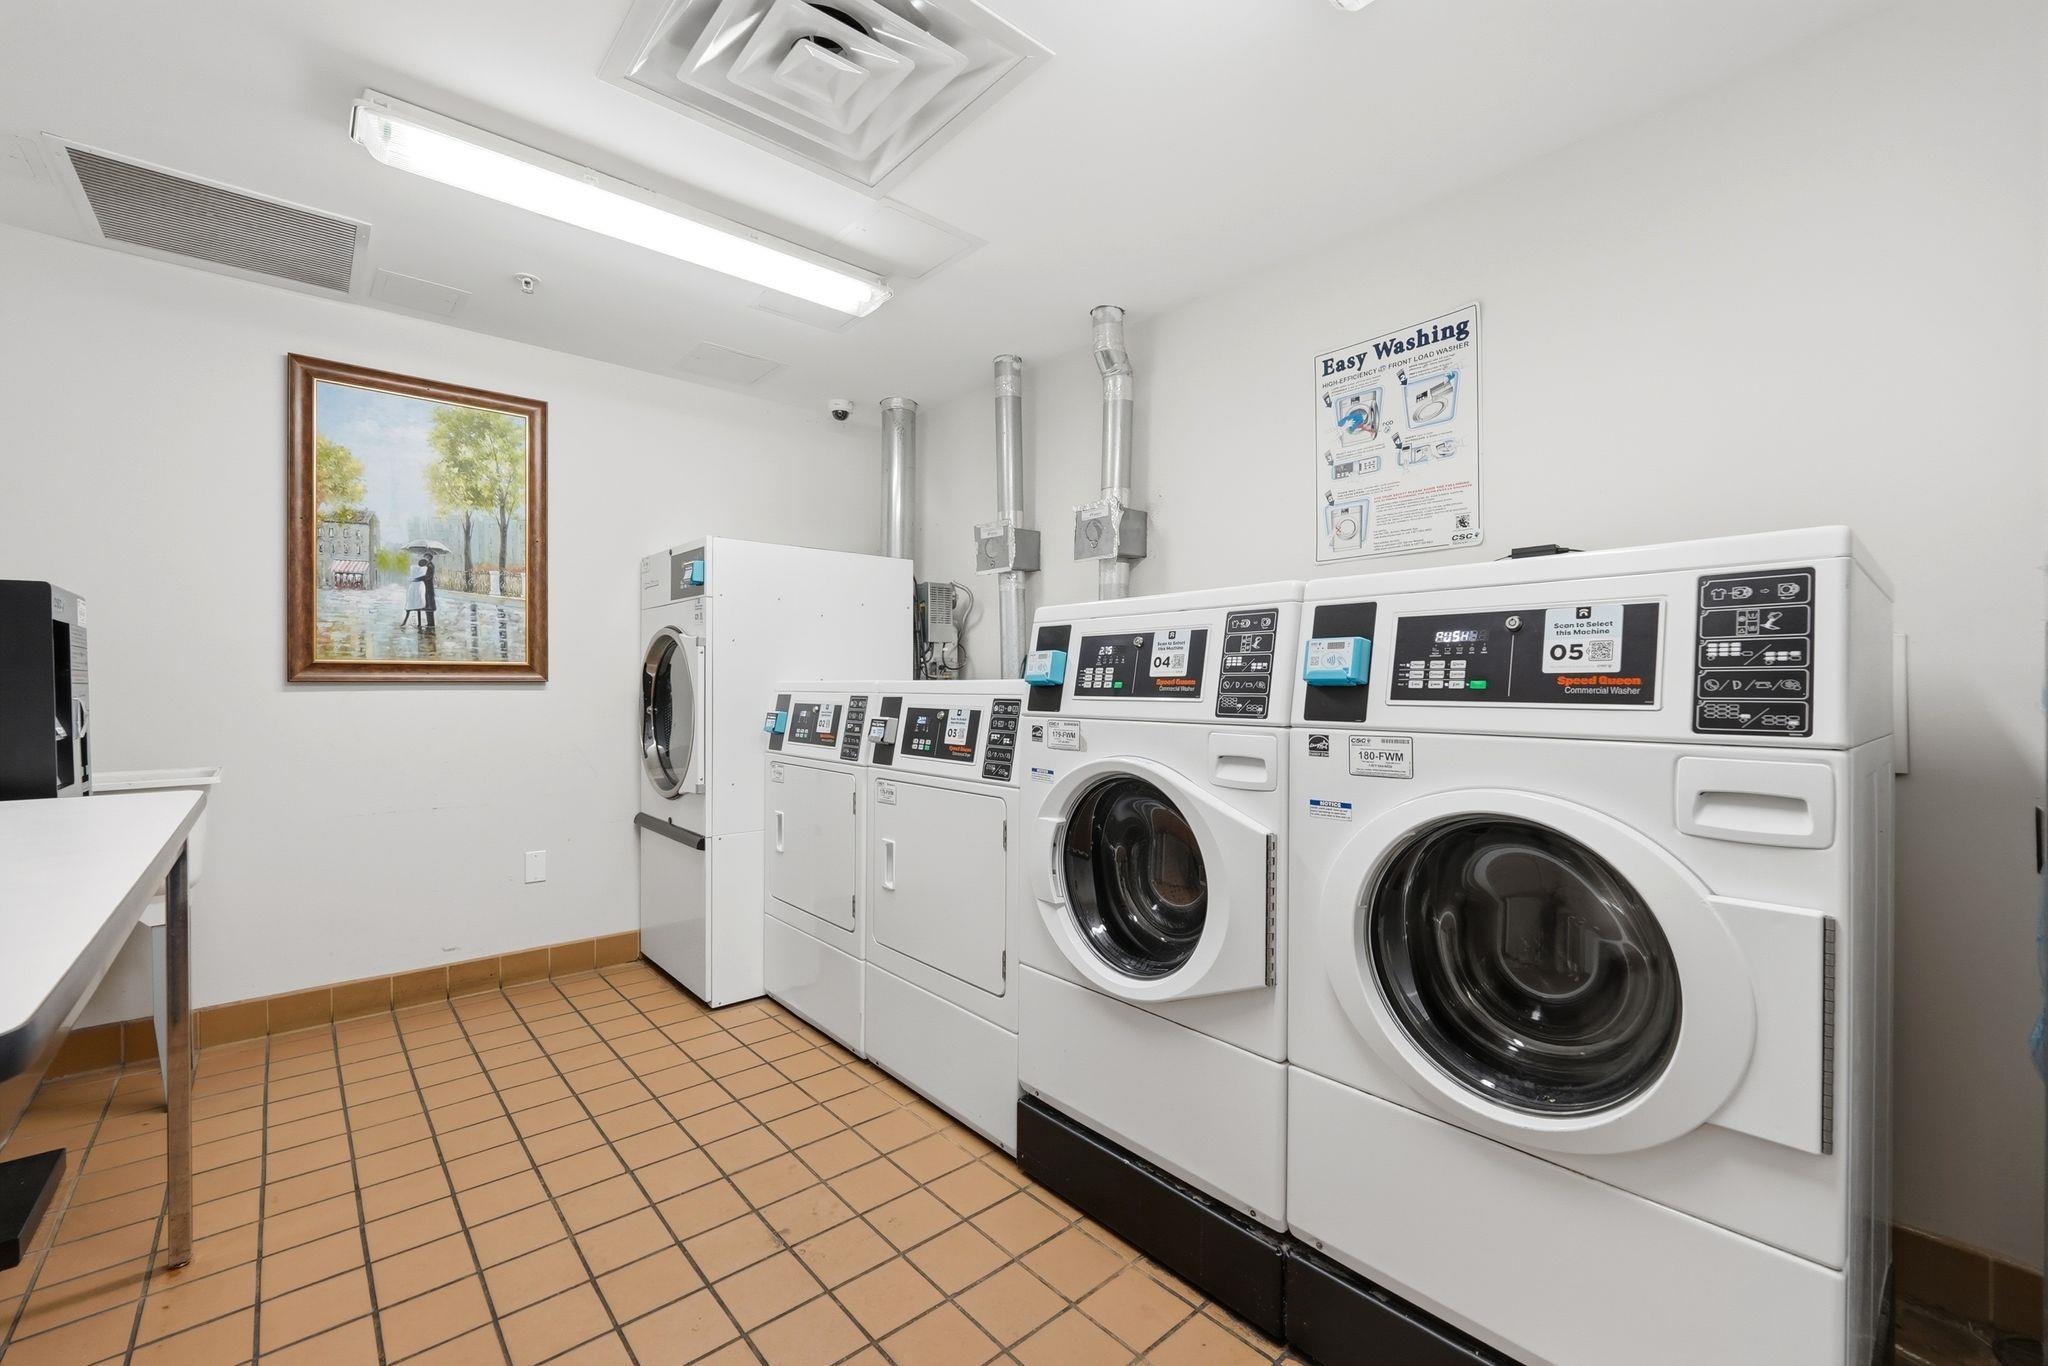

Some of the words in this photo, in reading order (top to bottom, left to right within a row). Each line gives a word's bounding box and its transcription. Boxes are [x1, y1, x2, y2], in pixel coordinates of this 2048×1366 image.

[1322, 352, 1368, 377] Easy
[1373, 319, 1470, 360] Washing
[1388, 357, 1412, 369] FRONT
[1413, 351, 1434, 362] LOAD
[1435, 341, 1470, 356] WASHER
[1322, 367, 1377, 388] HIGH-EFFICIENCY
[1451, 532, 1473, 541] CSC
[1586, 620, 1613, 628] Select
[1550, 643, 1584, 660] 05
[1153, 656, 1170, 668] 04
[1556, 675, 1598, 686] Speed
[1598, 675, 1642, 685] Queen
[1564, 686, 1609, 694] Commercial
[1610, 686, 1640, 695] Washer
[947, 728, 958, 738] 03
[1358, 751, 1404, 762] 180-FWM
